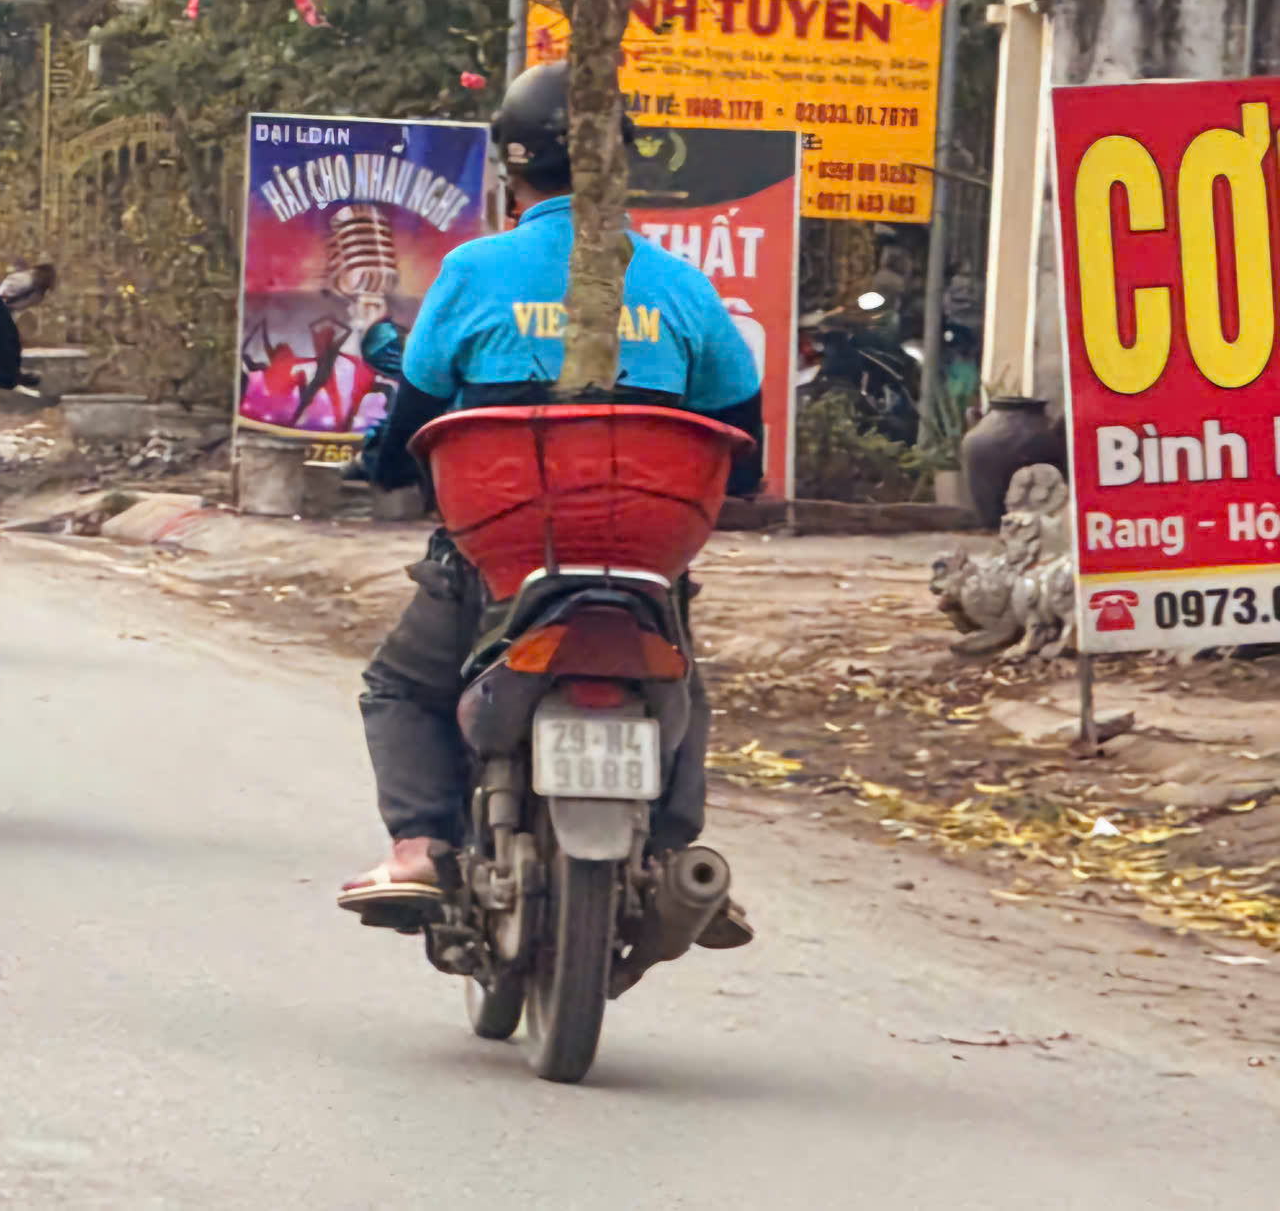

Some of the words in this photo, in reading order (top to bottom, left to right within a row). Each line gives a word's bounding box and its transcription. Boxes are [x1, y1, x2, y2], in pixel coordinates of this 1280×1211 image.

[641, 207, 765, 278] THẤT
[1075, 101, 1280, 395] CƠ
[616, 304, 661, 343] AM
[1096, 420, 1249, 487] Bình
[1086, 511, 1184, 556] Rang
[1154, 585, 1280, 632] 0973.
